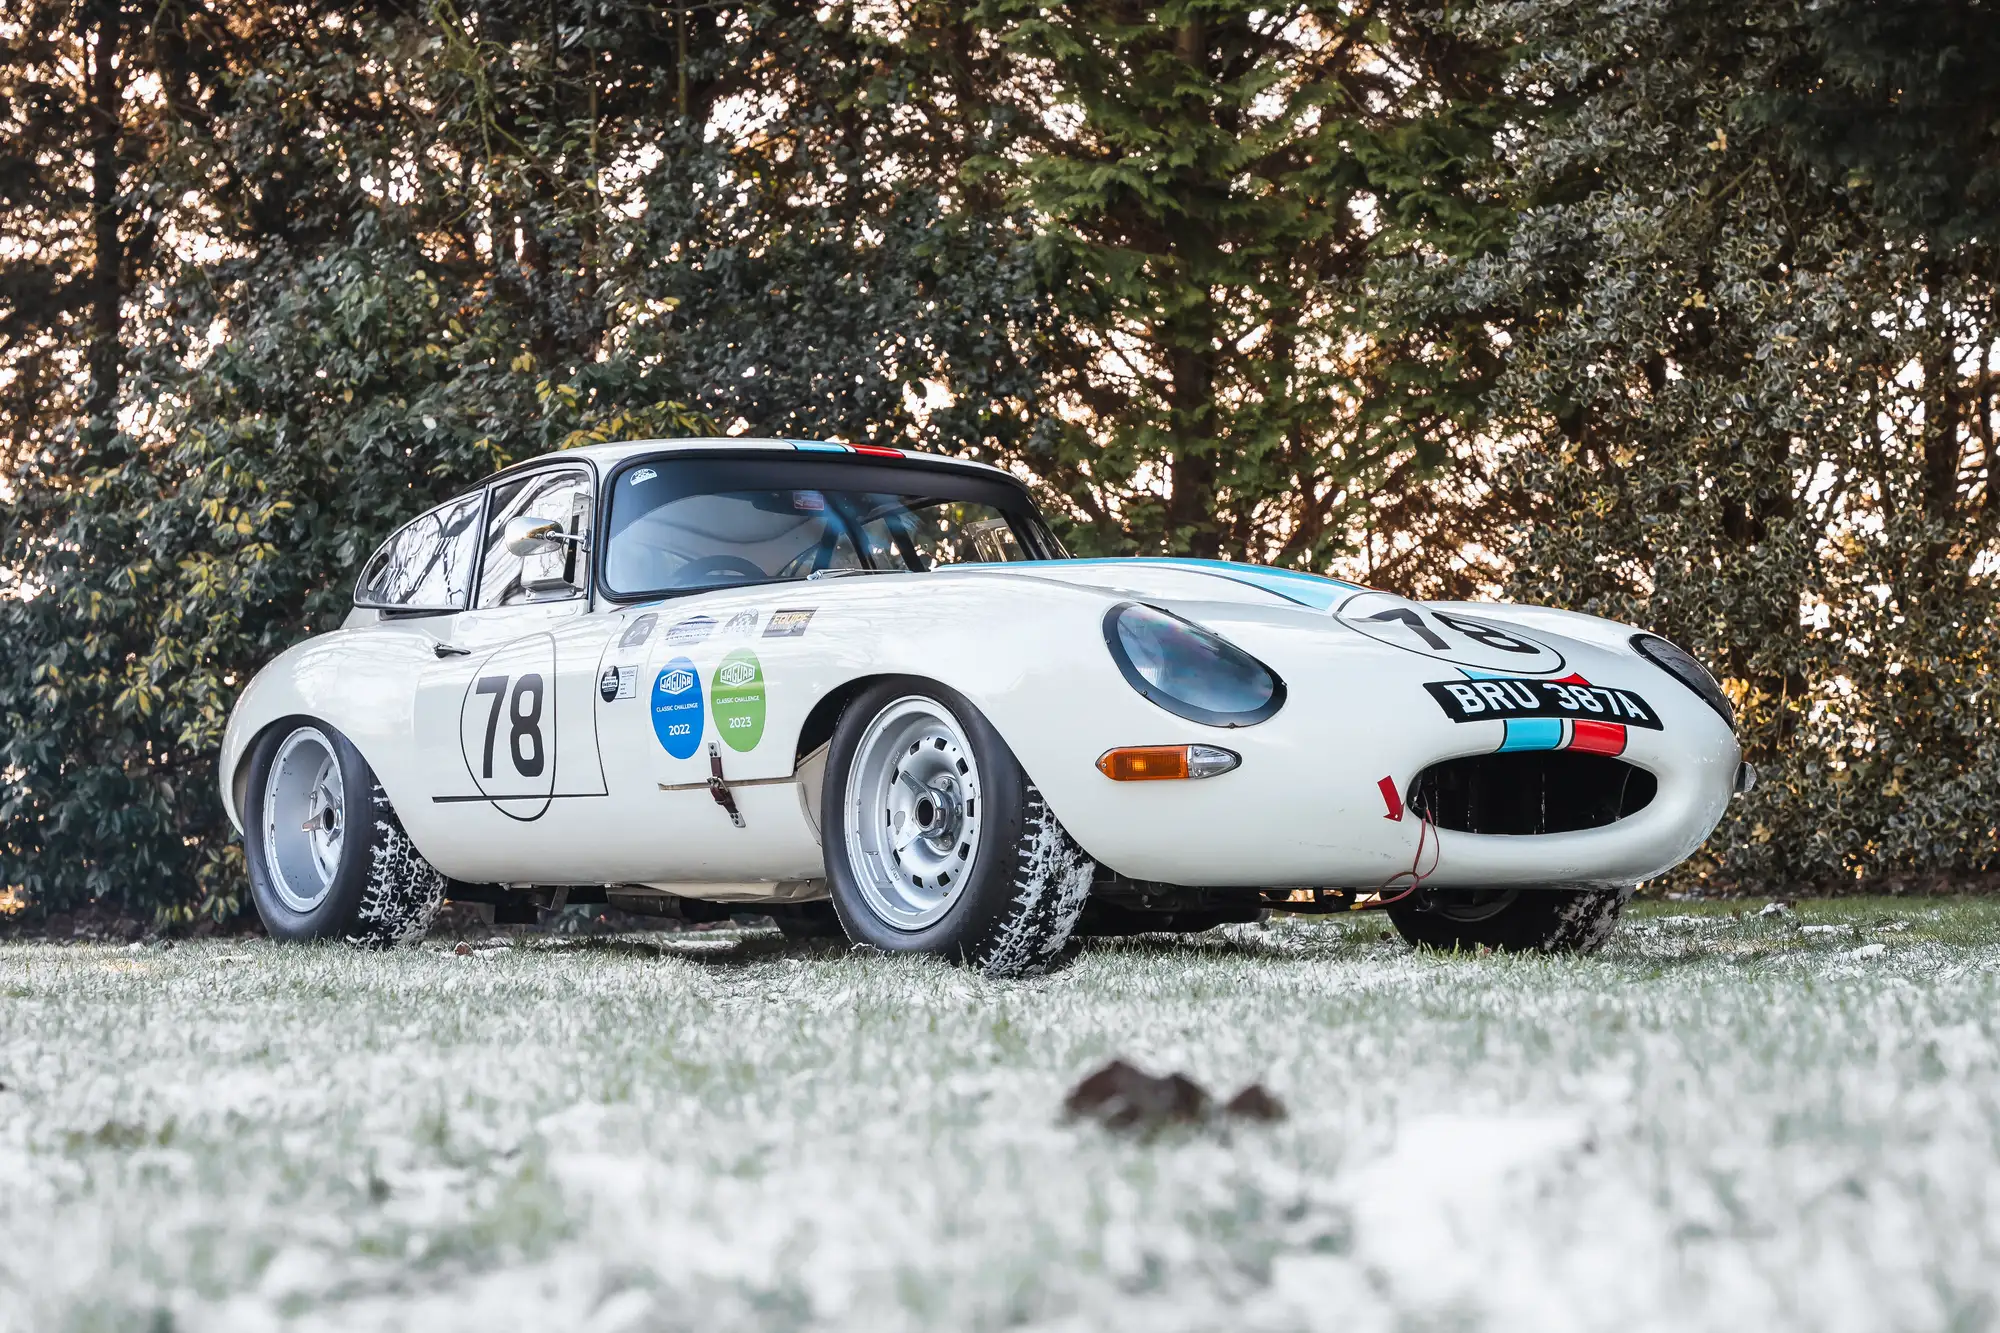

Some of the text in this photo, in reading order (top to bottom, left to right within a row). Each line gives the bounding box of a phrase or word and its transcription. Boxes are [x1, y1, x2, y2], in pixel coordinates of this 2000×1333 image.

[1351, 608, 1541, 654] 78
[661, 672, 692, 692] JAGUAR
[720, 664, 754, 685] JAGUAR
[656, 702, 699, 713] CLASSIC CHALLENGE
[716, 694, 760, 705] CLASSIC CHALLENGE
[1443, 681, 1649, 721] BRU 387A
[476, 673, 545, 779] 78
[668, 723, 691, 736] 2022
[728, 716, 752, 729] 2023
